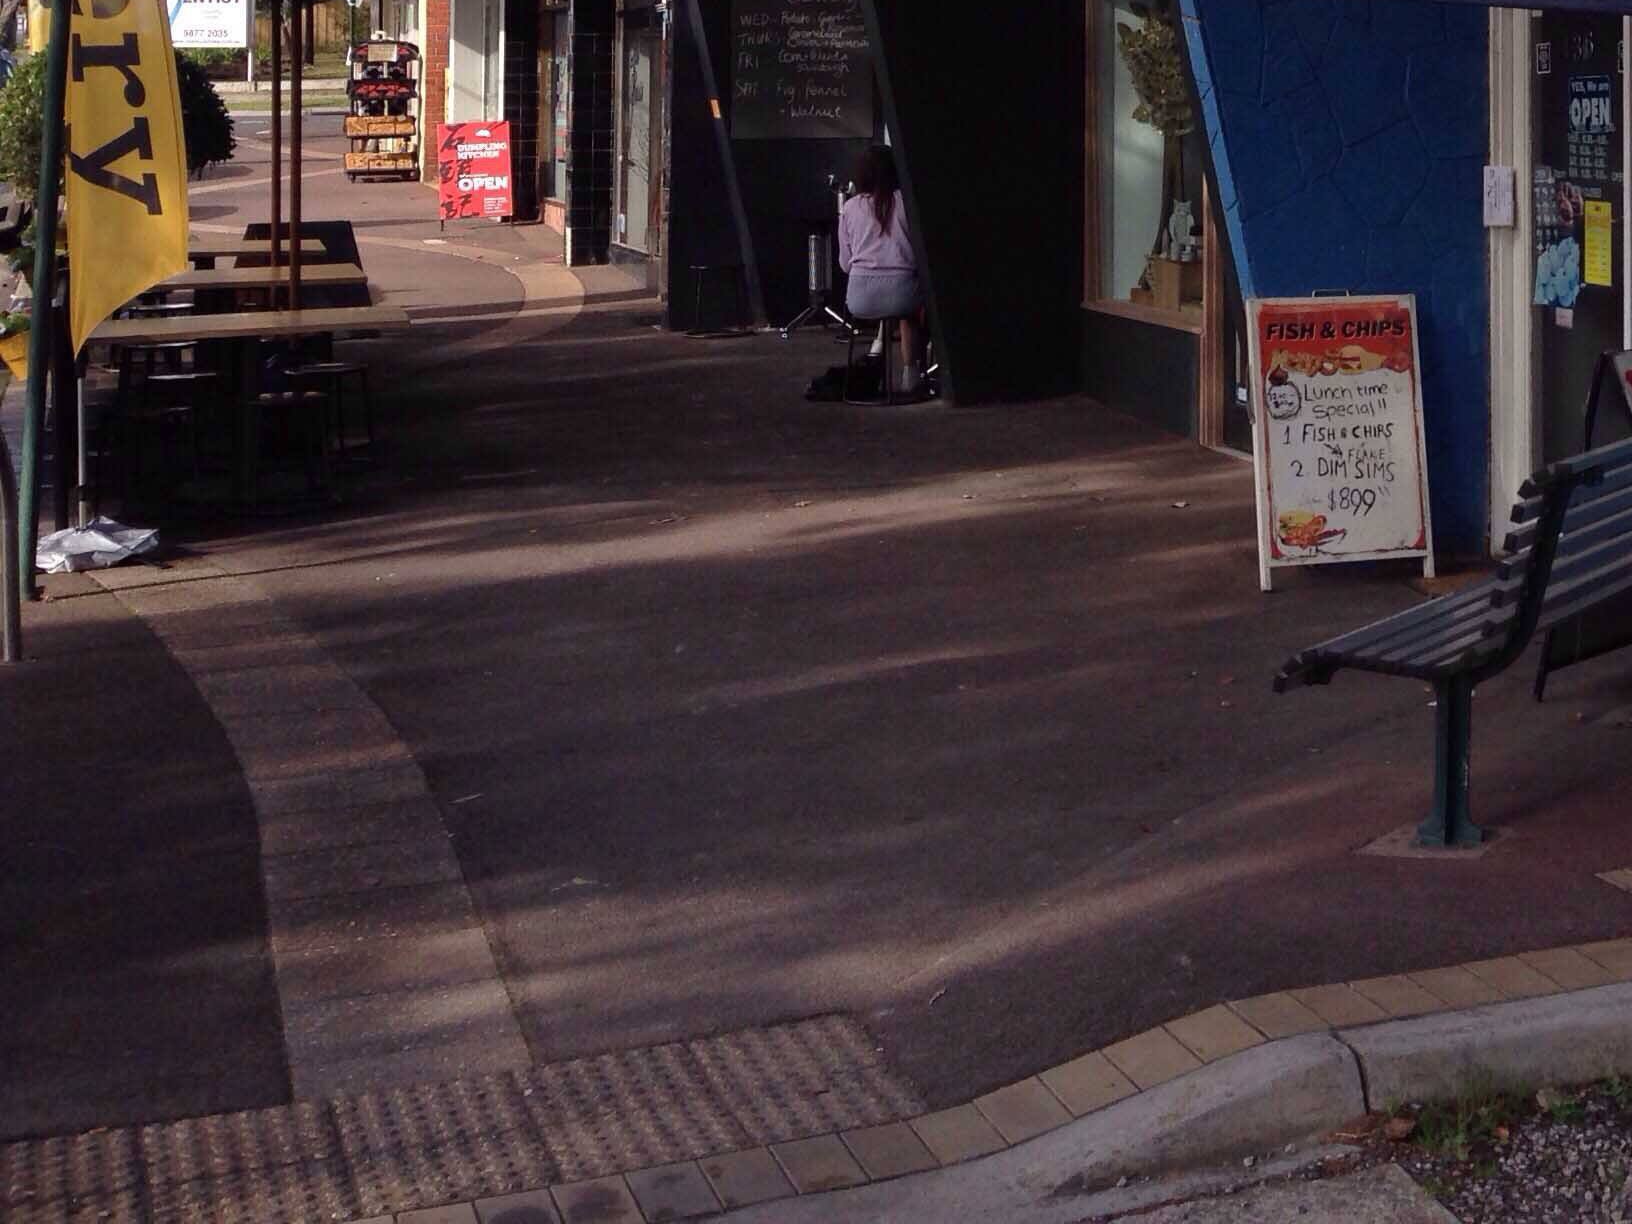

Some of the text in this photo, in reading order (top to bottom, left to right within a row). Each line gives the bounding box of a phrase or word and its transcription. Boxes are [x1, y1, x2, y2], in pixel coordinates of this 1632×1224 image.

[1570, 97, 1611, 127] OPEN
[456, 142, 507, 152] DUMPLING
[456, 150, 500, 160] KITCHEN
[458, 175, 509, 192] OPEN
[1265, 319, 1407, 342] FISH & CHIPS
[1303, 382, 1353, 404] Lunch
[1302, 422, 1337, 443] FISH
[1351, 422, 1394, 440] CHIPS
[1290, 456, 1395, 482] 2 DIM SIMS
